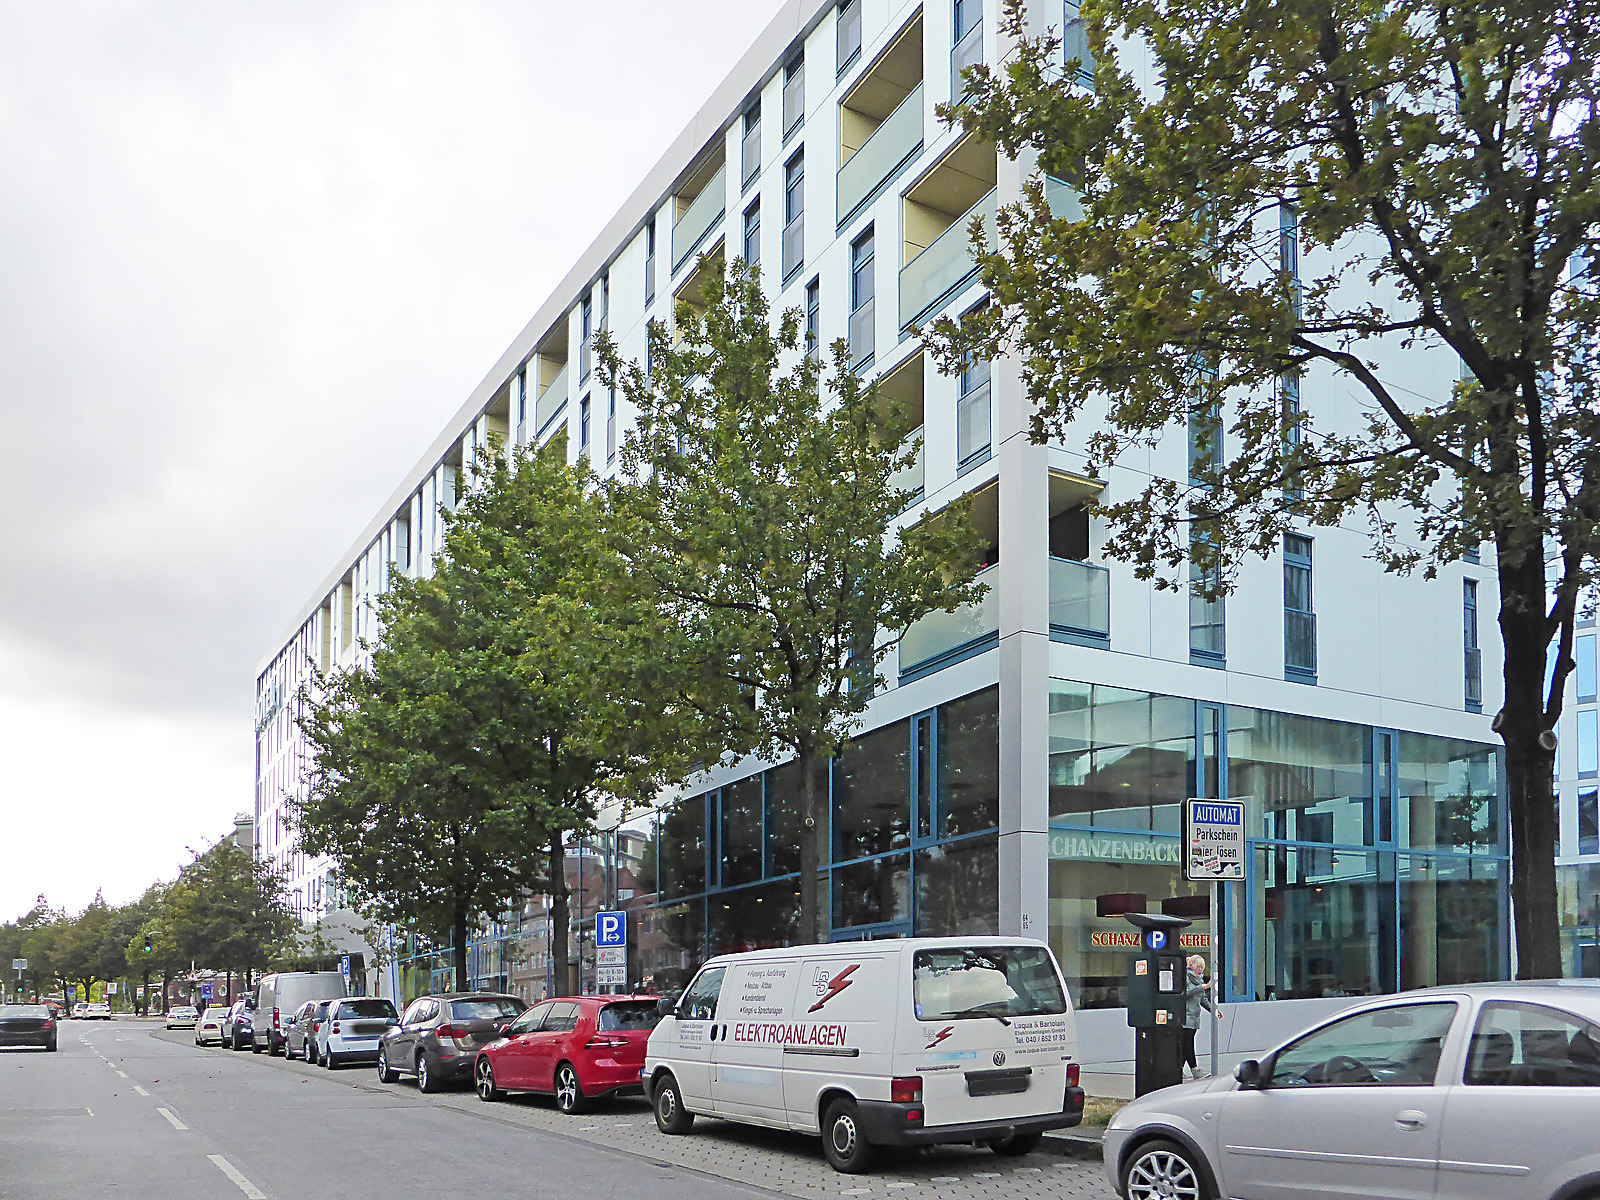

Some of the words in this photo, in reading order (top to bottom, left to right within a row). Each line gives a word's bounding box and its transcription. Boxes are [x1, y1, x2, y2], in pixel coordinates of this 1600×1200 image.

[1195, 806, 1238, 823] AUTOMAT
[1196, 827, 1238, 842] Parkschein
[1048, 836, 1181, 863] CHANZENBÄCK
[1216, 845, 1237, 858] lösen
[602, 916, 619, 942] P
[1152, 930, 1164, 949] P
[734, 1022, 847, 1046] ELEKTROANLAGEN
[1013, 1022, 1033, 1030] Laqua
[1025, 1035, 1037, 1043] 040
[1041, 1034, 1052, 1042] 652
[1058, 1033, 1066, 1041] 93
